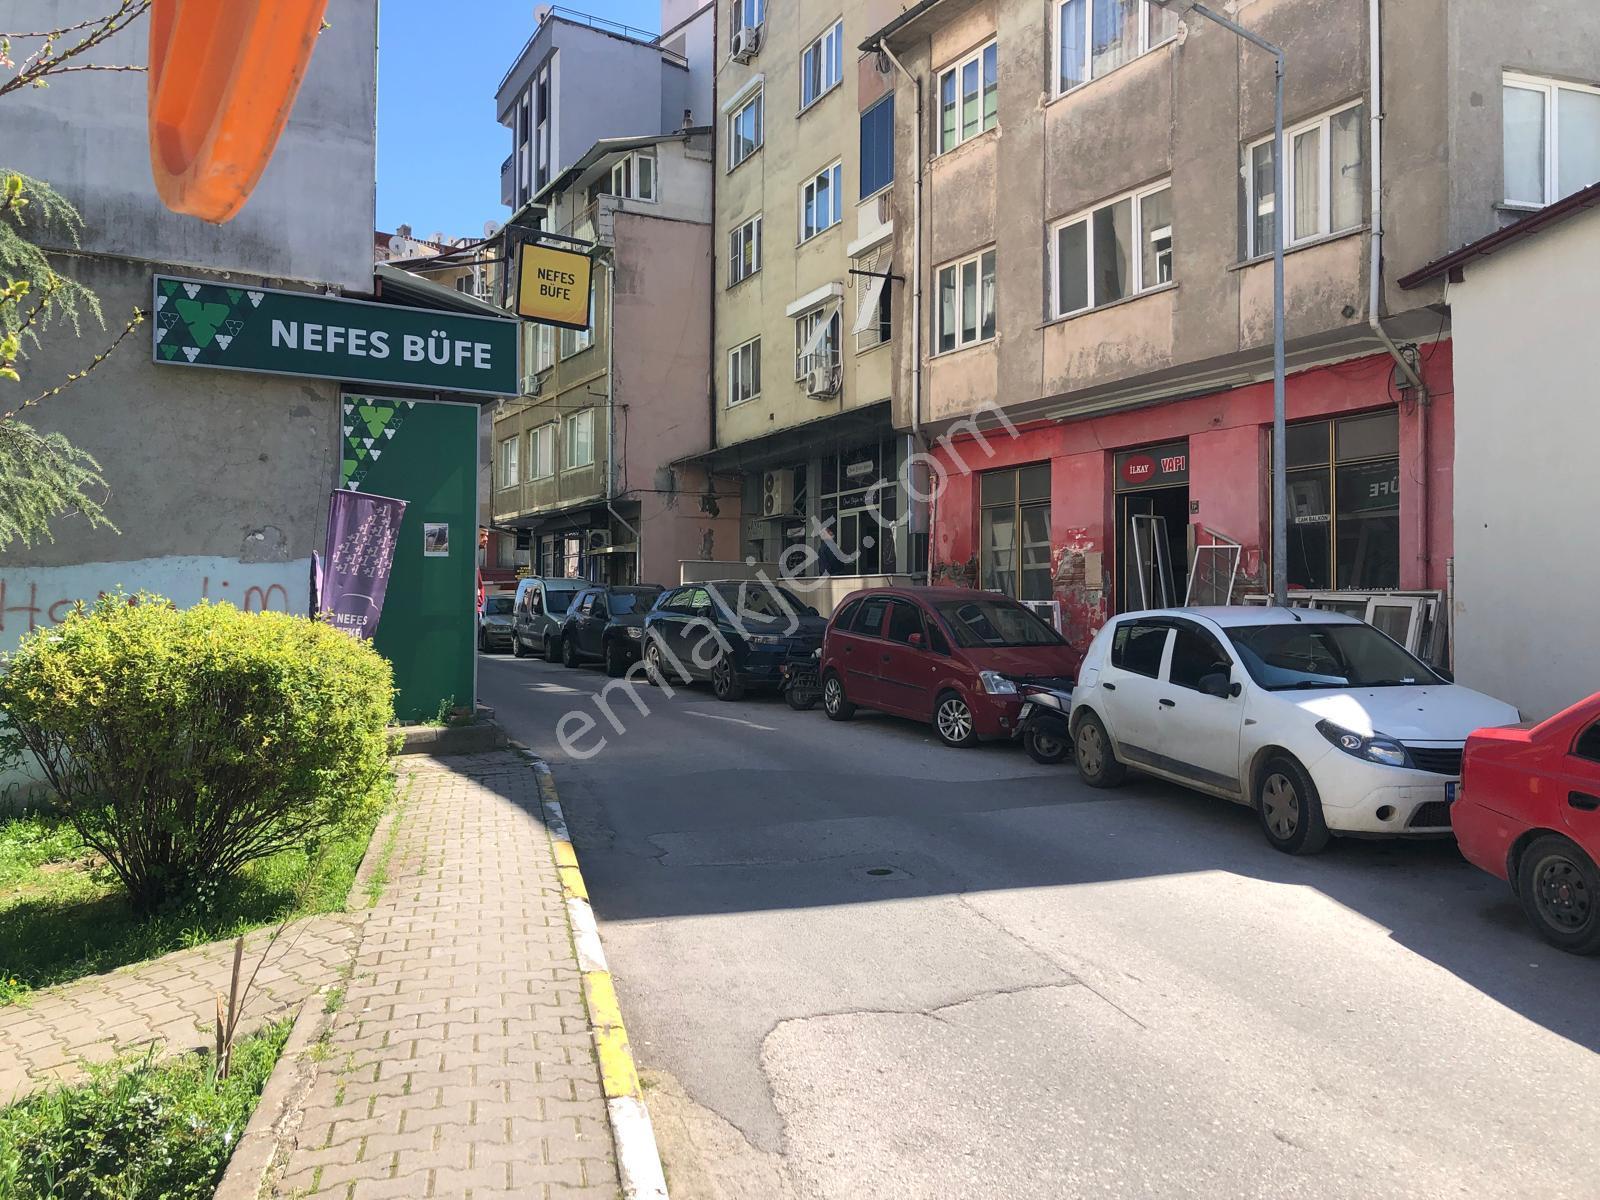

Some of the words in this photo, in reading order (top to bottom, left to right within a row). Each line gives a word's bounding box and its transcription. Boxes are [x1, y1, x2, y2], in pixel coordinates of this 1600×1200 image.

[537, 267, 575, 285] NEFES
[540, 283, 571, 301] BÜFE
[271, 319, 390, 359] NEFES
[403, 329, 492, 370] BÜFE
[1129, 464, 1149, 475] İLKAY
[1160, 455, 1186, 474] YAPI
[336, 612, 369, 626] NEFES
